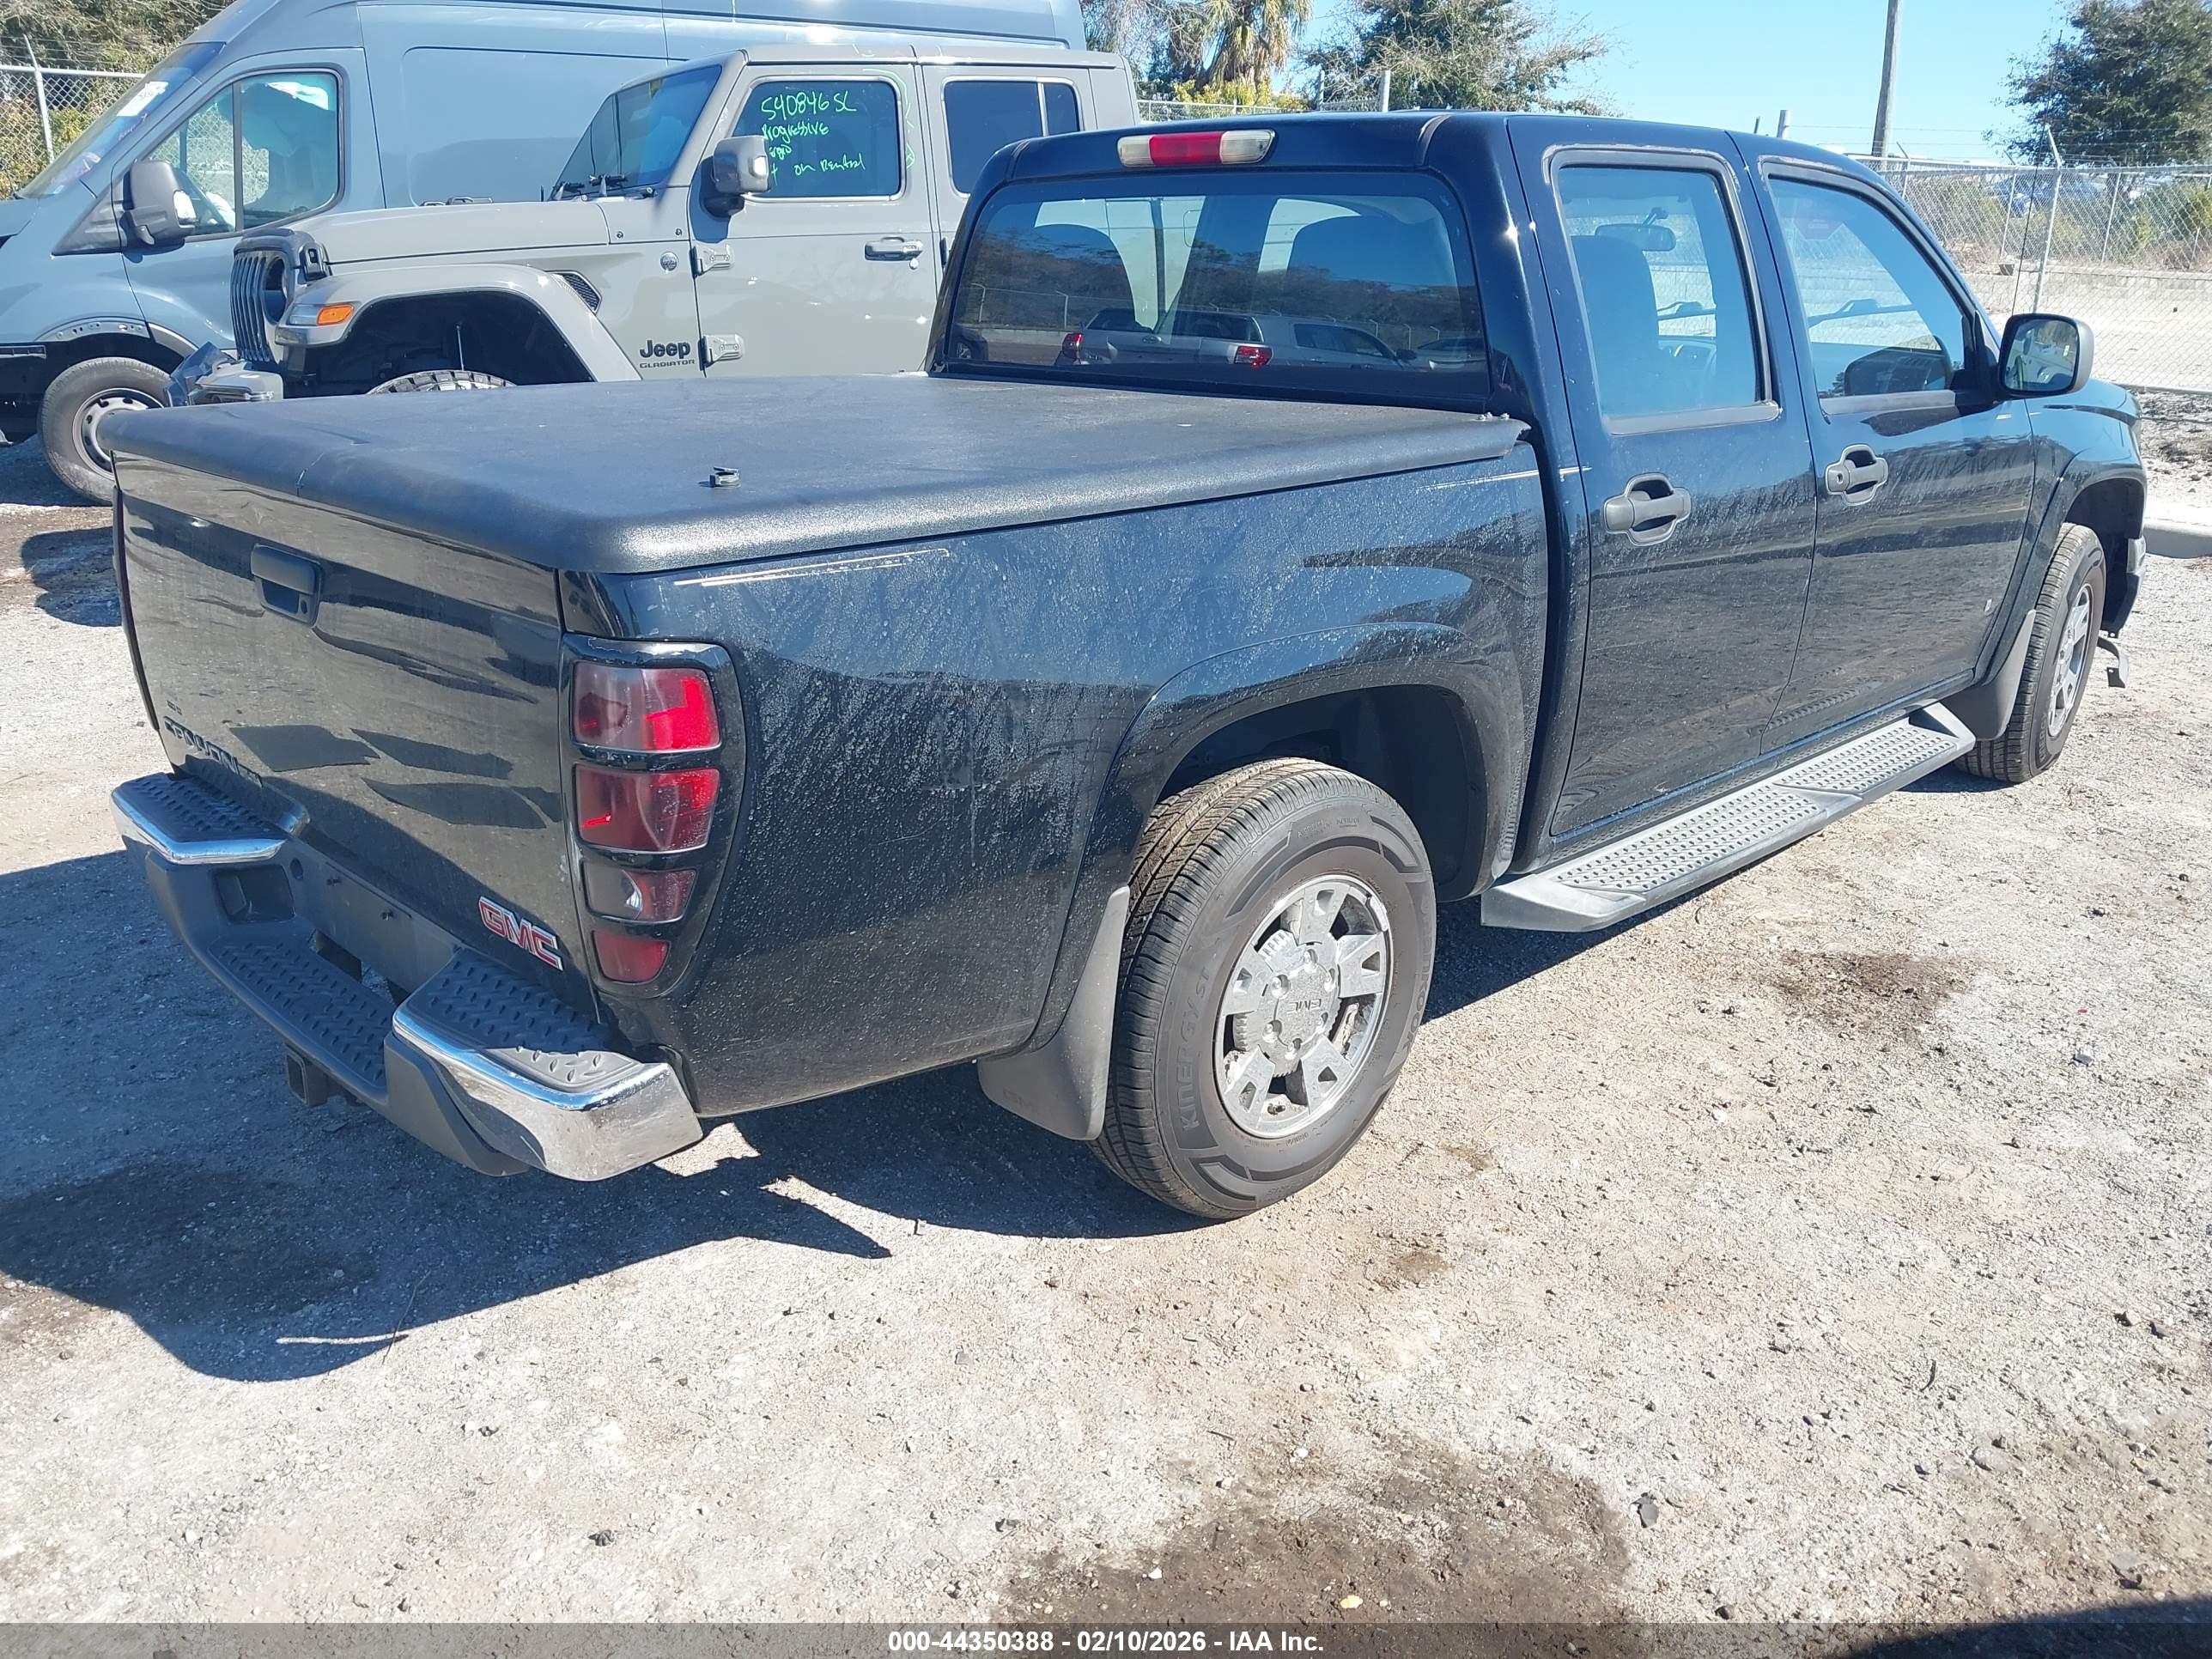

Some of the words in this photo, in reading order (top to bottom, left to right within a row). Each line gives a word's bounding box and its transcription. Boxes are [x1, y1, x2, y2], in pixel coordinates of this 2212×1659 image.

[793, 163, 816, 176] on
[640, 339, 690, 359] Jeep
[639, 359, 696, 369] GLADIATOR
[478, 896, 563, 971] GMC
